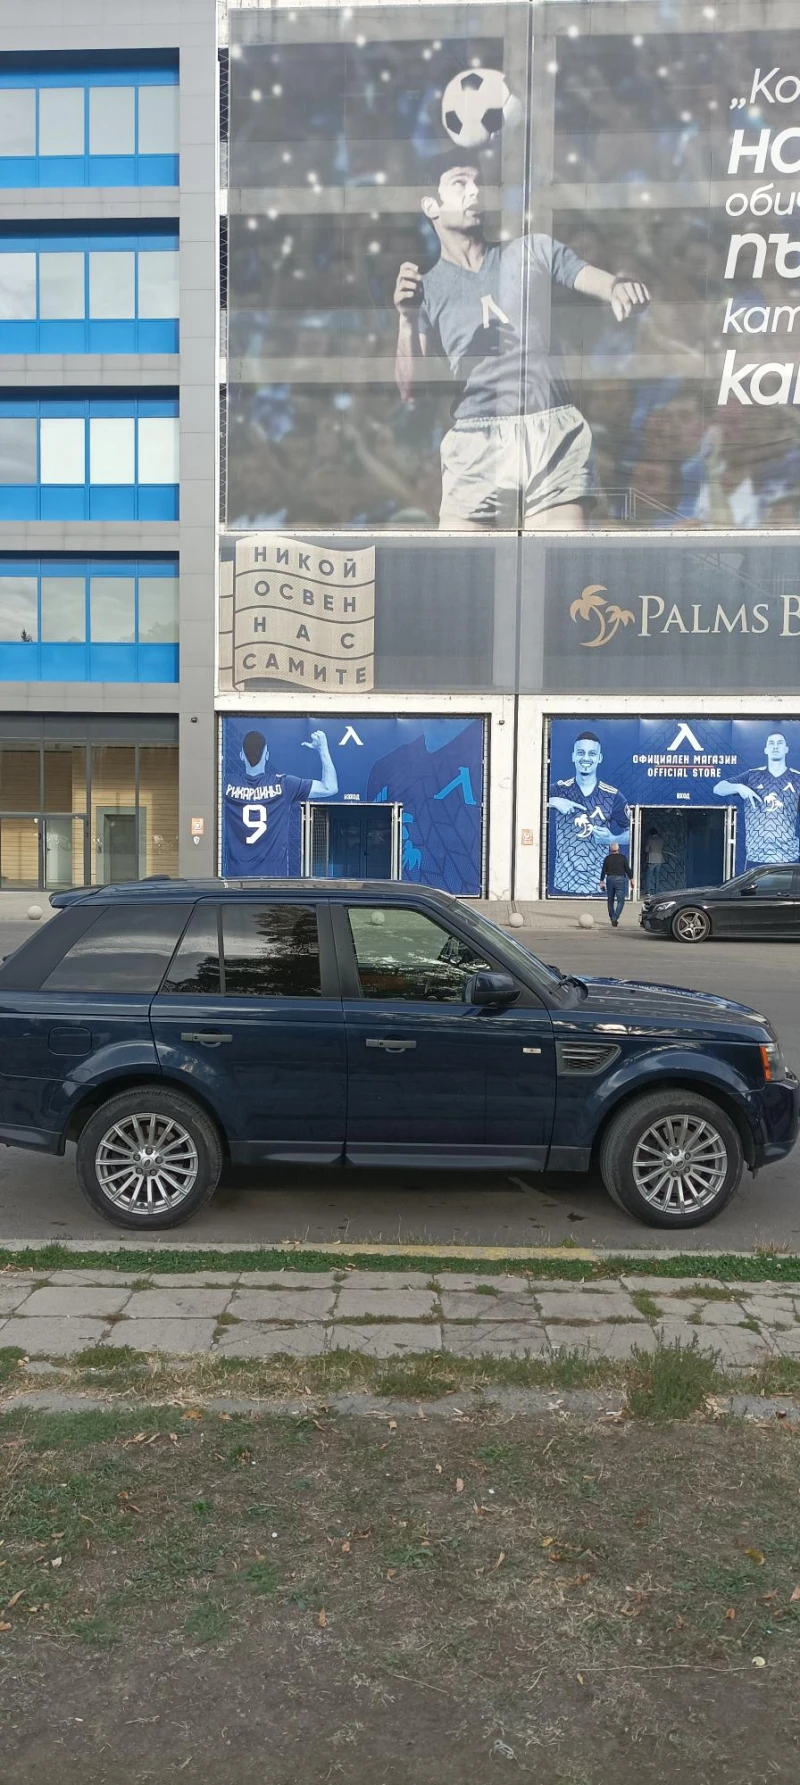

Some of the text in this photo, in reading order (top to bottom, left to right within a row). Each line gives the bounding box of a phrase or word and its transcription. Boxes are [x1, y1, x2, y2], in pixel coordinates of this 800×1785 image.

[725, 182, 800, 216] оби
[717, 349, 800, 405] ка
[254, 546, 357, 578] НИКОЙ
[253, 580, 357, 613] ОСВЕН
[779, 595, 800, 637] B
[242, 653, 367, 685] САМИТЕ
[632, 754, 738, 766] ОФИЦИАЛЕН МАГАЗИН
[647, 767, 722, 778] OFFICIAL STORE
[225, 784, 283, 801] РИКАРДИНЬО
[676, 792, 691, 800] ВХОД
[242, 804, 268, 845] 9
